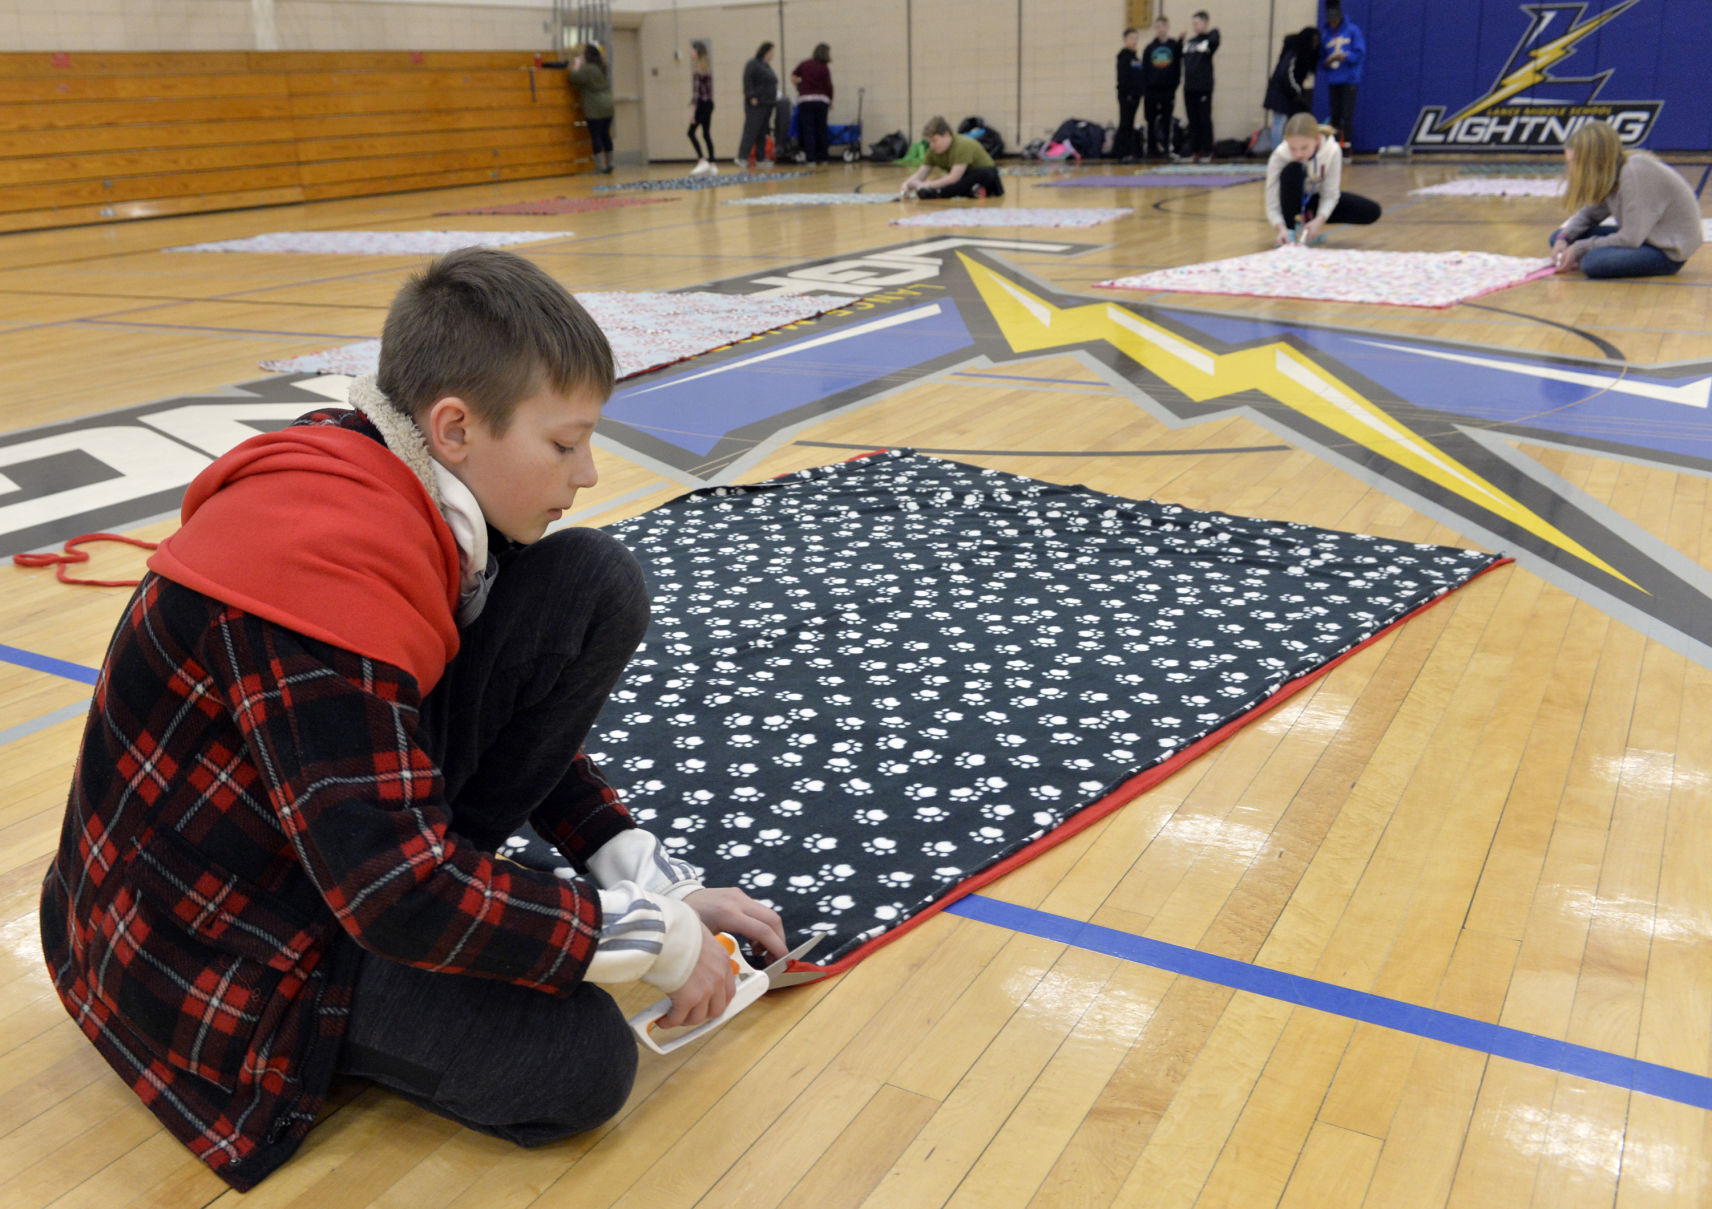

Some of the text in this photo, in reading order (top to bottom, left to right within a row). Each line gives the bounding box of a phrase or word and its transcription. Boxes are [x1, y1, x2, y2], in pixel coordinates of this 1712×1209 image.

[1524, 106, 1566, 116] MIDDLE
[1570, 105, 1613, 115] SCHOOL
[1415, 111, 1650, 143] LIGHTNIG
[826, 282, 947, 317] LANCE
